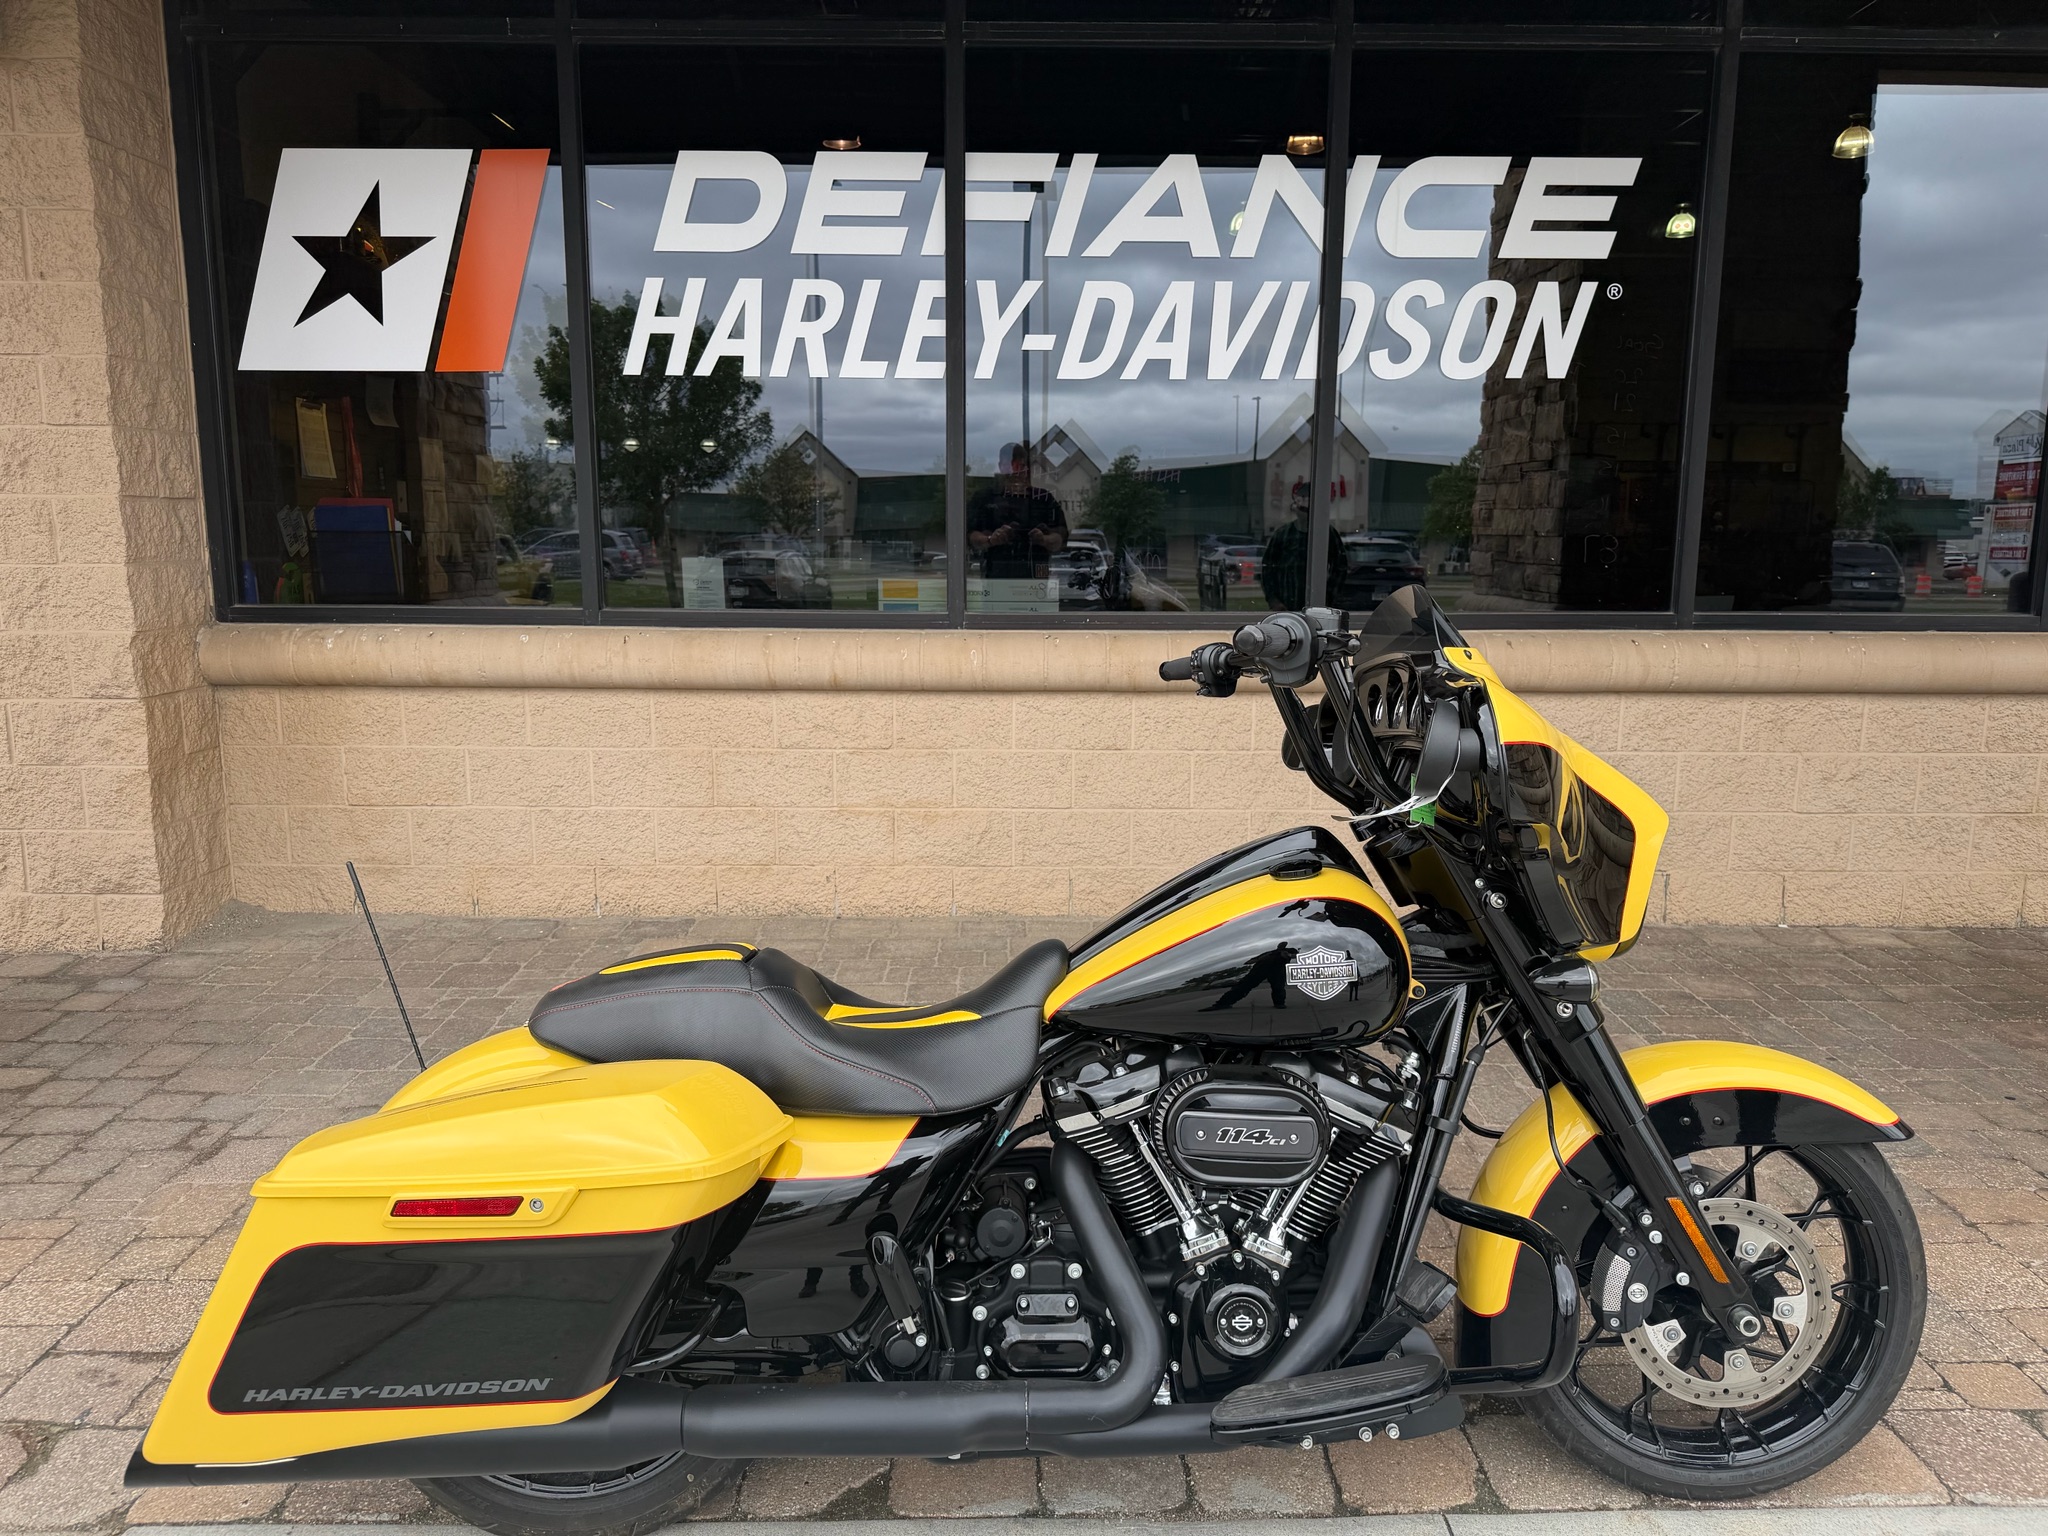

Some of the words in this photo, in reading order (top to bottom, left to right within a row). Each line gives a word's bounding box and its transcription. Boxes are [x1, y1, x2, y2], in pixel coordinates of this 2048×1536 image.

[653, 150, 1643, 259] DEFIANCE
[623, 277, 1600, 380] HARLEY-DAVIDSON
[1306, 952, 1338, 965] MOTOR
[1292, 965, 1352, 980] HARLEY-DAVIDSON
[1215, 1126, 1273, 1145] 114
[243, 1377, 552, 1403] HARLEY-DAVIDSON
